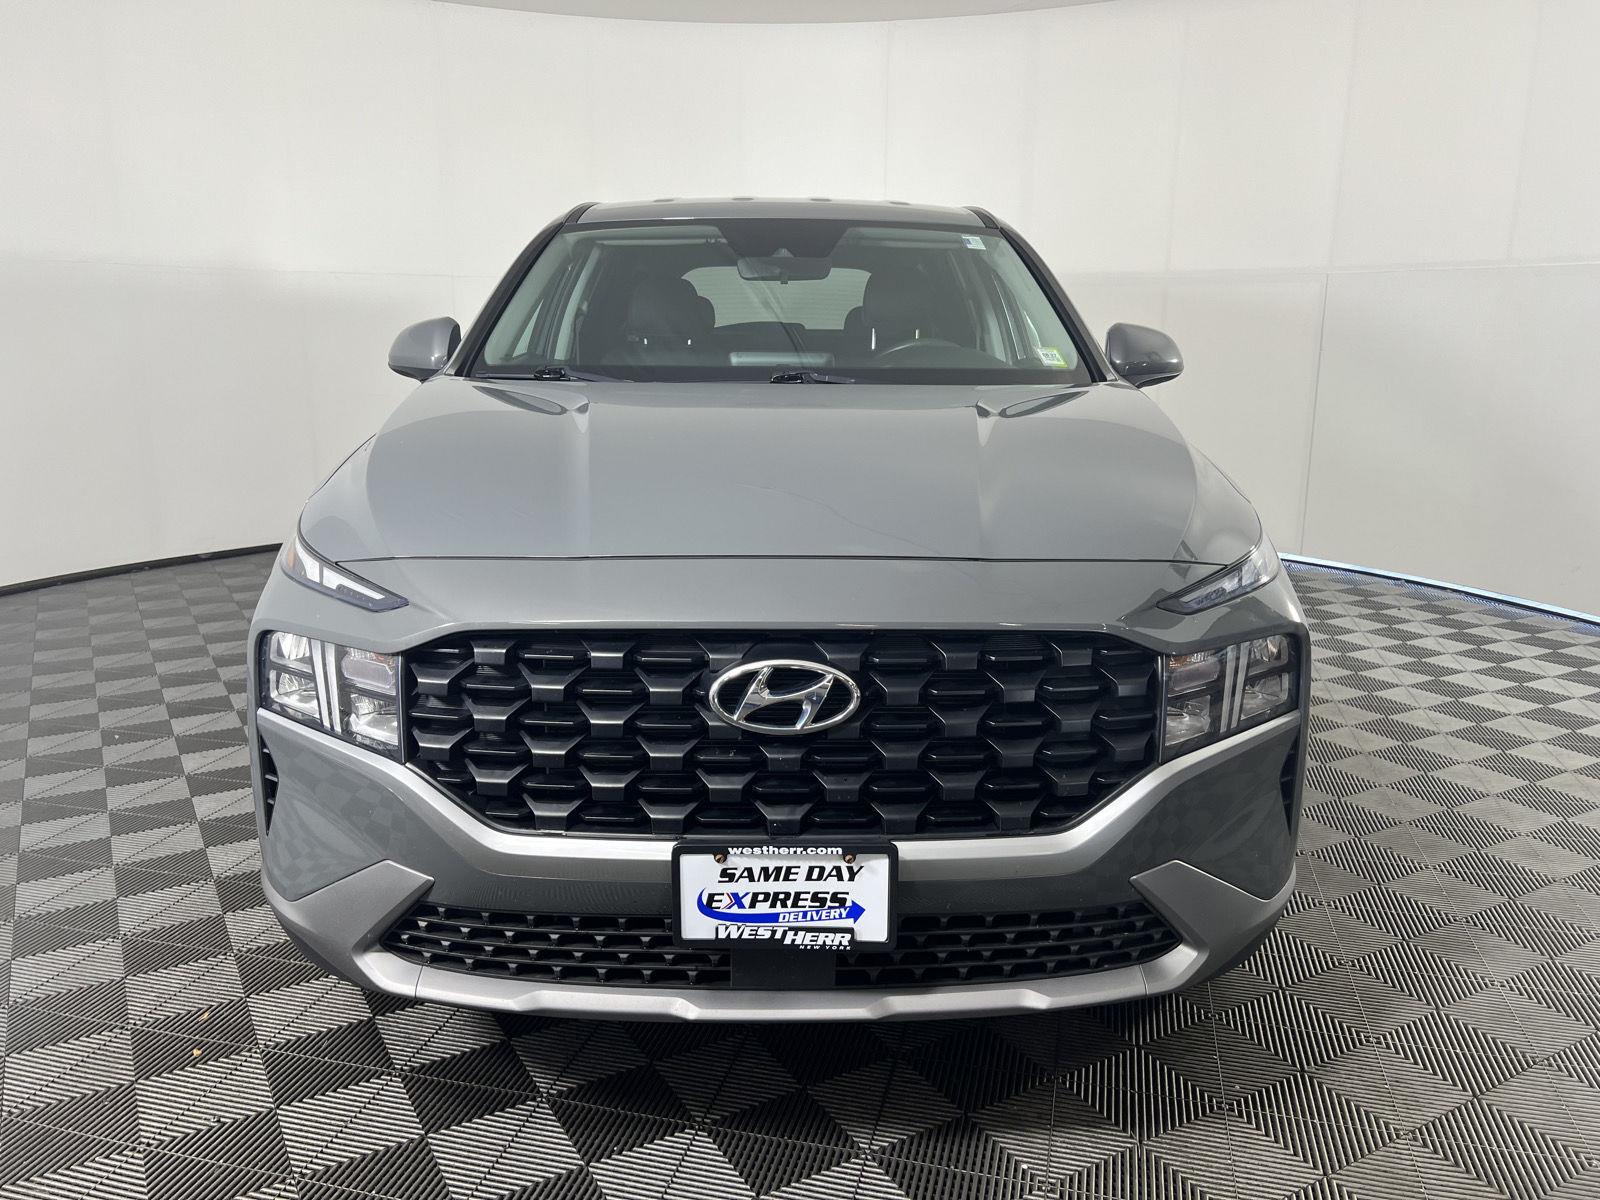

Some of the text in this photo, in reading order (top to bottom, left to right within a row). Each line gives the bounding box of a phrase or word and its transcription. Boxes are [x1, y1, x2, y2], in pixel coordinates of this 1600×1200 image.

[728, 846, 843, 855] westherr.com
[718, 866, 865, 883] SAME DAY
[706, 892, 849, 909] EXPRESS
[779, 908, 850, 922] DELIVERY
